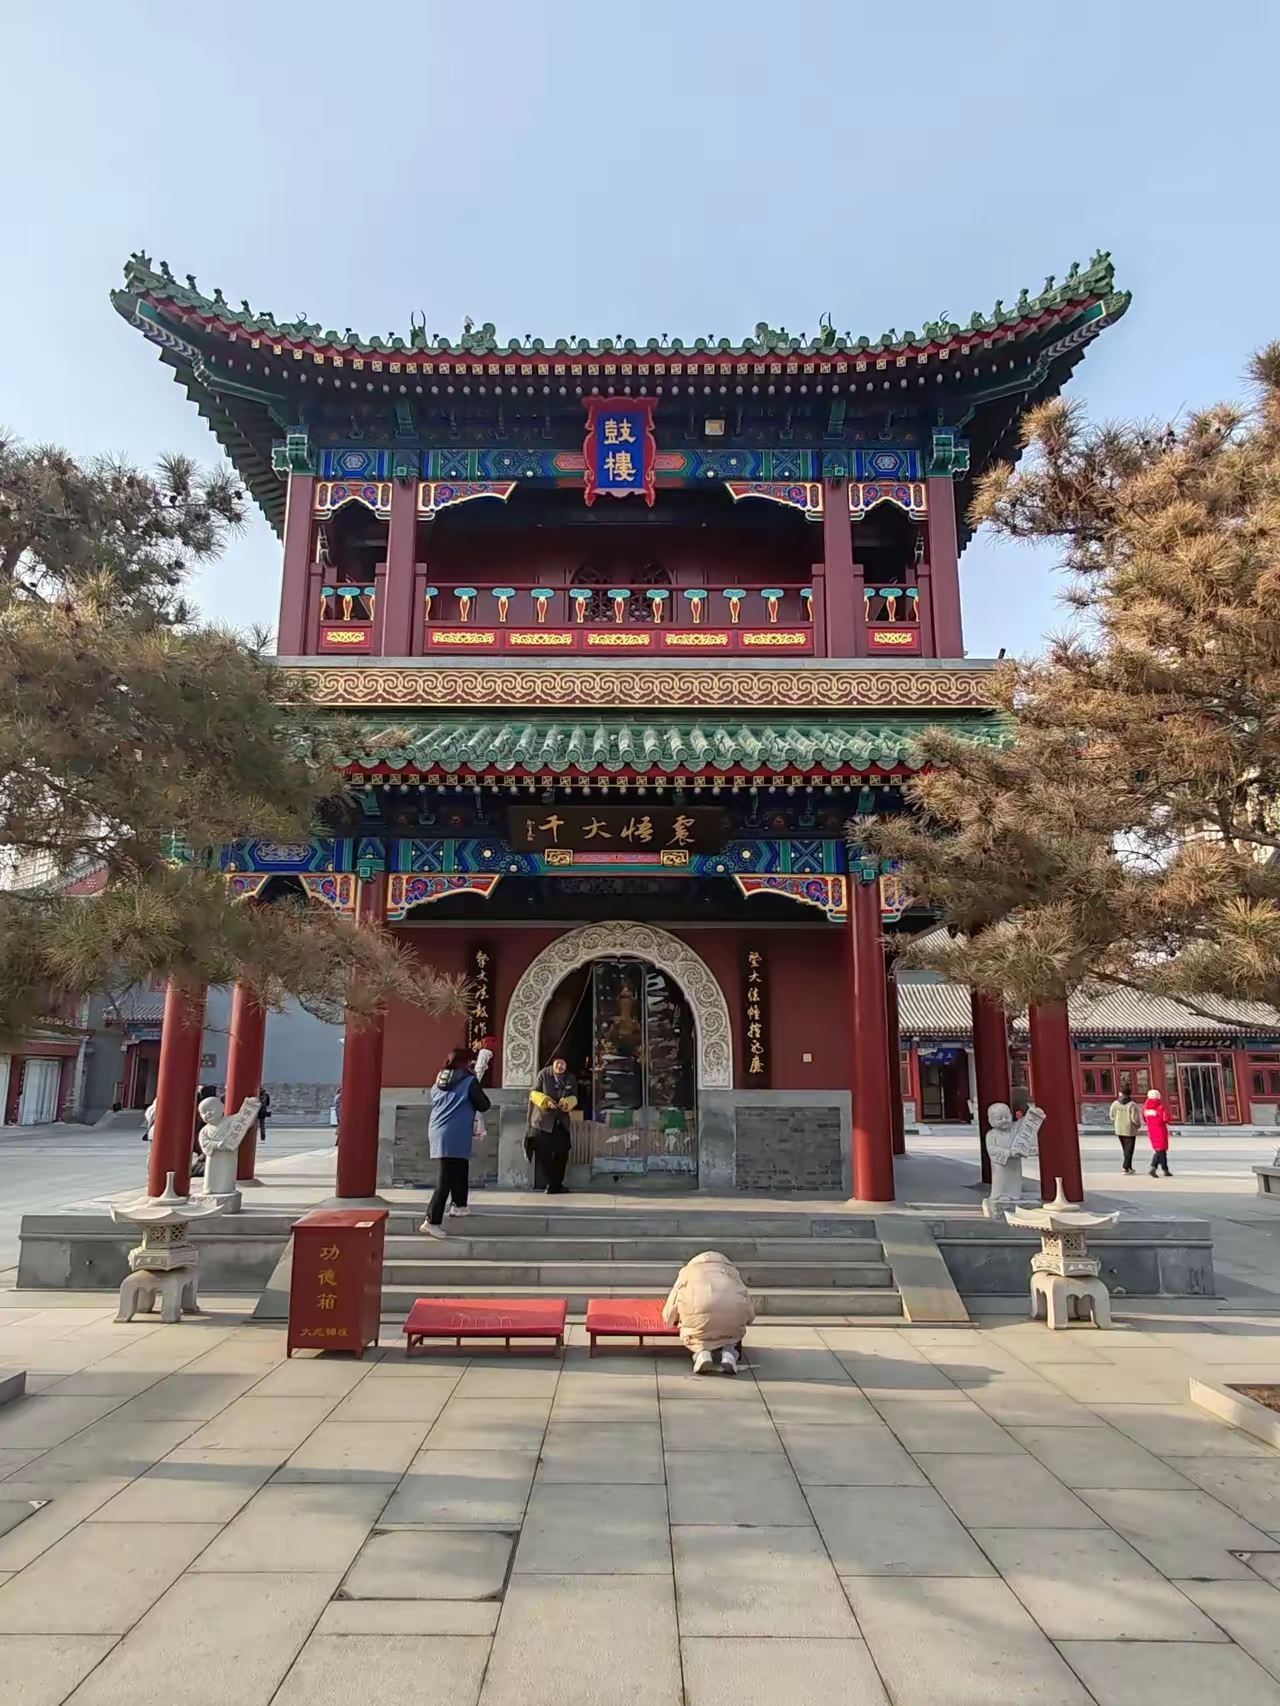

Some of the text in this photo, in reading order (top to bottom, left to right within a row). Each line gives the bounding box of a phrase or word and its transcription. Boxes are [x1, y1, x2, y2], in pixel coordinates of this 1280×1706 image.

[604, 418, 637, 482] 鼓樓
[316, 1244, 340, 1309] 功德箱
